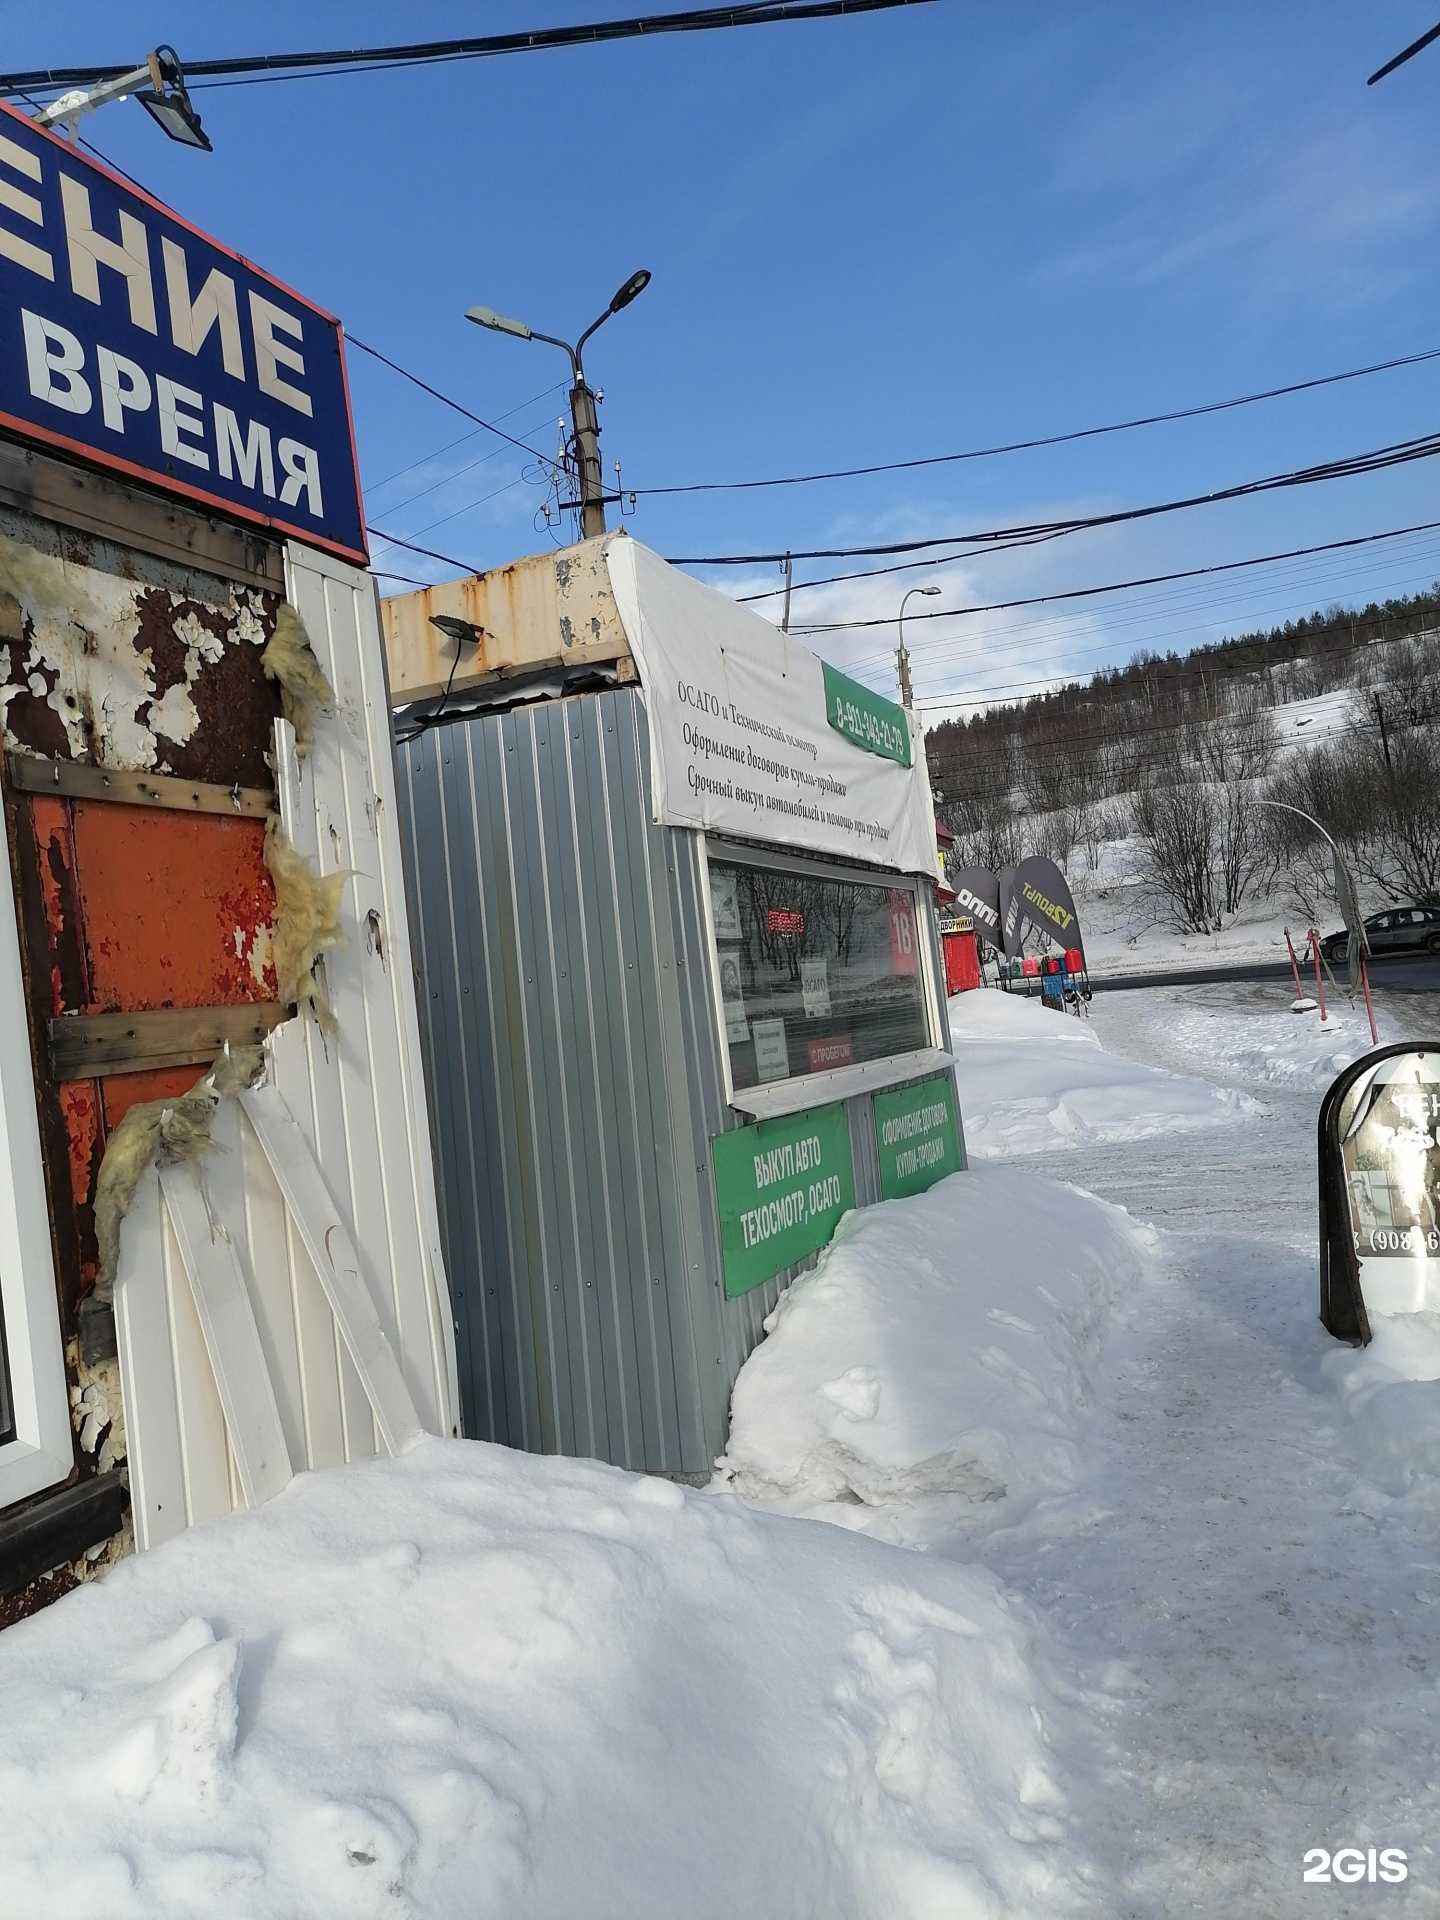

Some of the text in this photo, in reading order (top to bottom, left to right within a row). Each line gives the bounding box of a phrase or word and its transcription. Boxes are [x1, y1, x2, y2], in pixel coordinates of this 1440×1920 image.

[21, 308, 324, 519] ВРЕМЯ
[678, 681, 818, 760] ОСАГО и Технический осмотр
[683, 723, 847, 797] Оформление договоров купли-продажи
[688, 765, 733, 798] Срочный
[735, 787, 764, 812] выкуп
[766, 796, 820, 823] автомобилей
[827, 812, 853, 833] помощь
[853, 820, 865, 839] при
[940, 918, 973, 931] ДВОРНИКИ
[883, 1101, 948, 1145] ОФОРМЛЕНИЕ ДОГОВОРА
[896, 1136, 944, 1178] КУПЛИ-ПРОДАЖИ
[754, 1136, 821, 1189] ВЫКУП АВТО
[740, 1175, 840, 1248] ТЕХОСМОТР, ОСАГО
